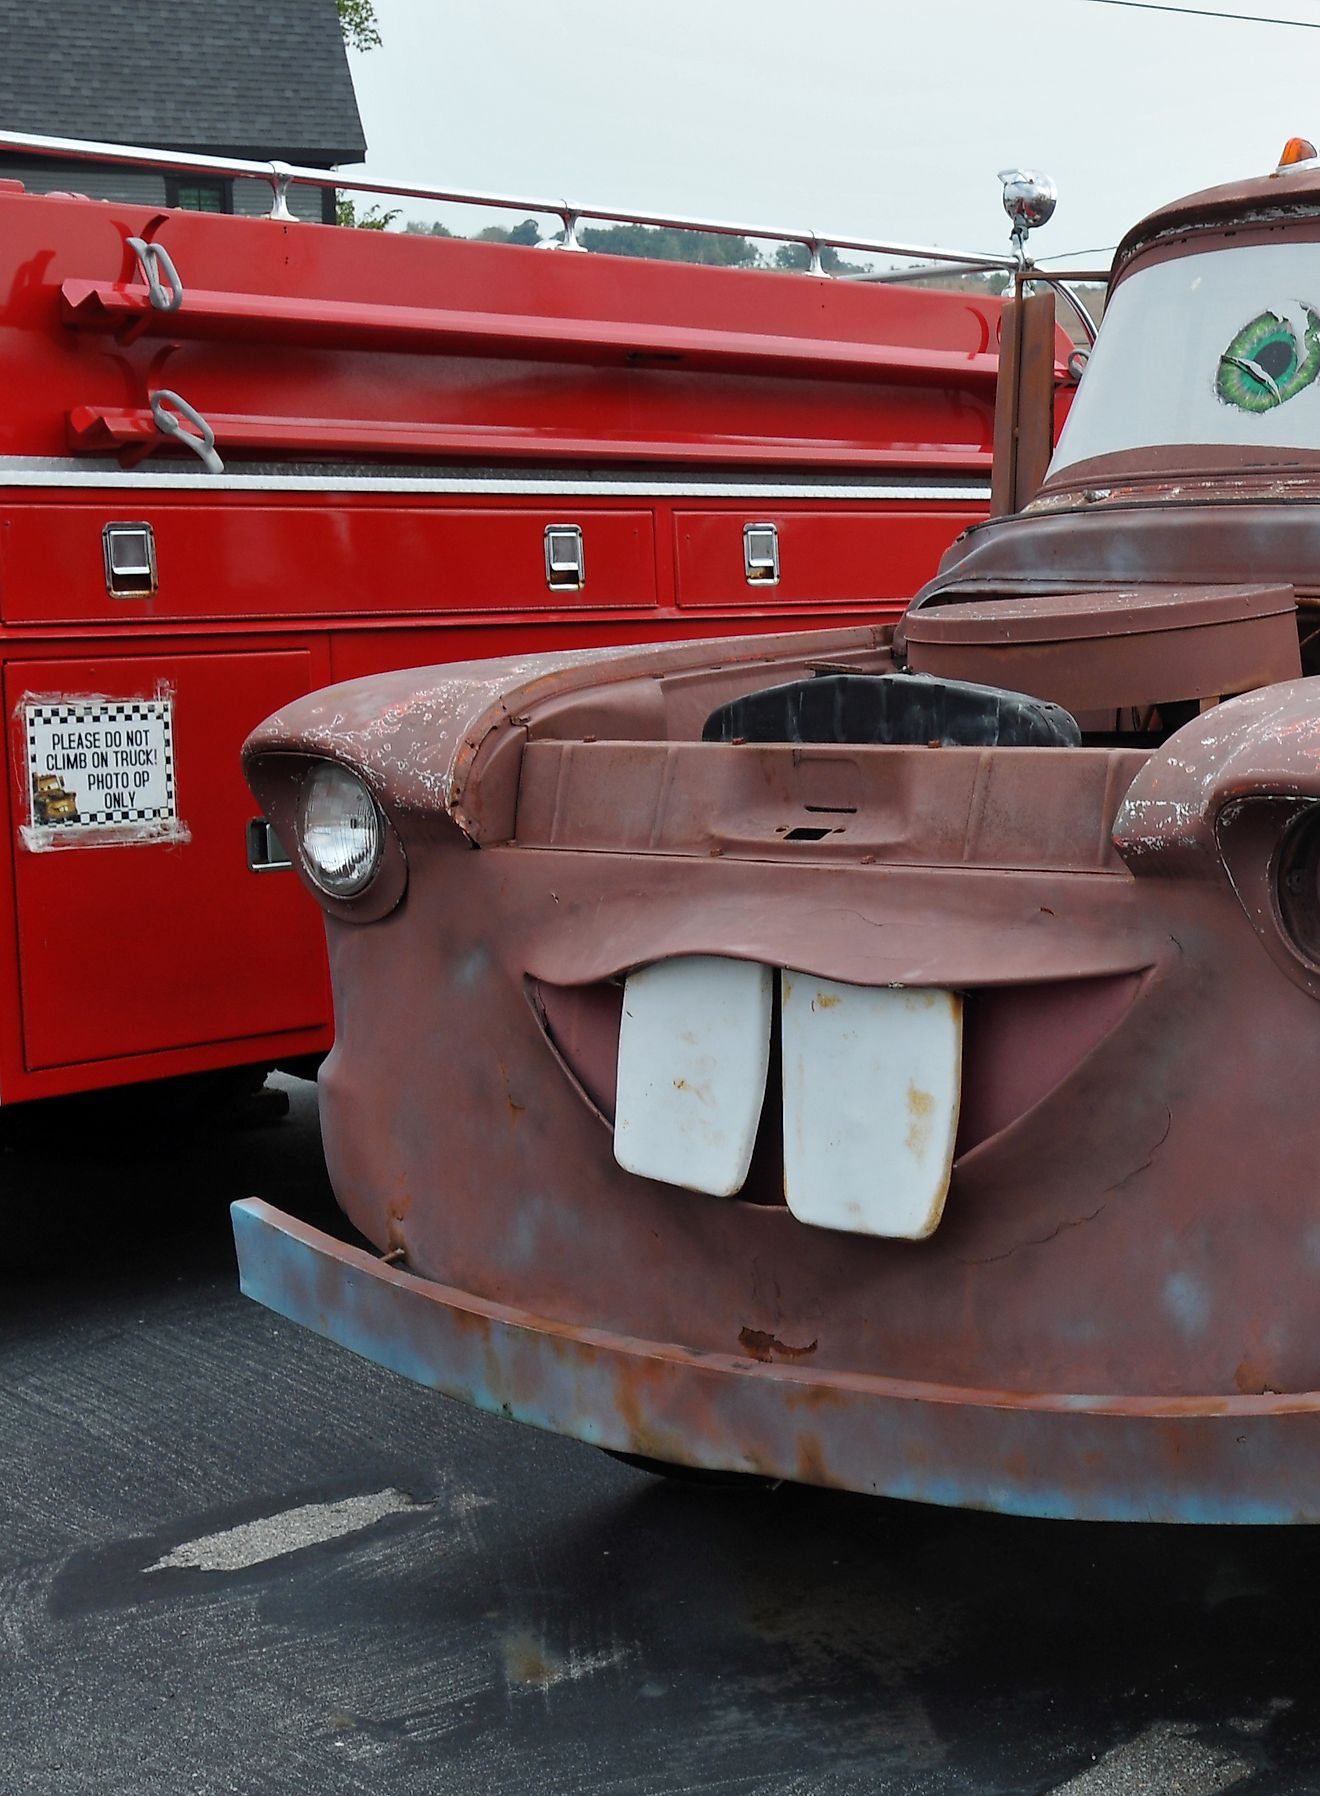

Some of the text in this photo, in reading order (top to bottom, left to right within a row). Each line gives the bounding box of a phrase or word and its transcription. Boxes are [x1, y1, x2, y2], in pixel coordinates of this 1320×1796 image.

[52, 729, 150, 750] PLEASE DO NOT
[46, 749, 158, 771] CLIMB ON TRUCK!
[87, 770, 150, 791] PHOTO OP
[104, 791, 136, 810] ONLY
